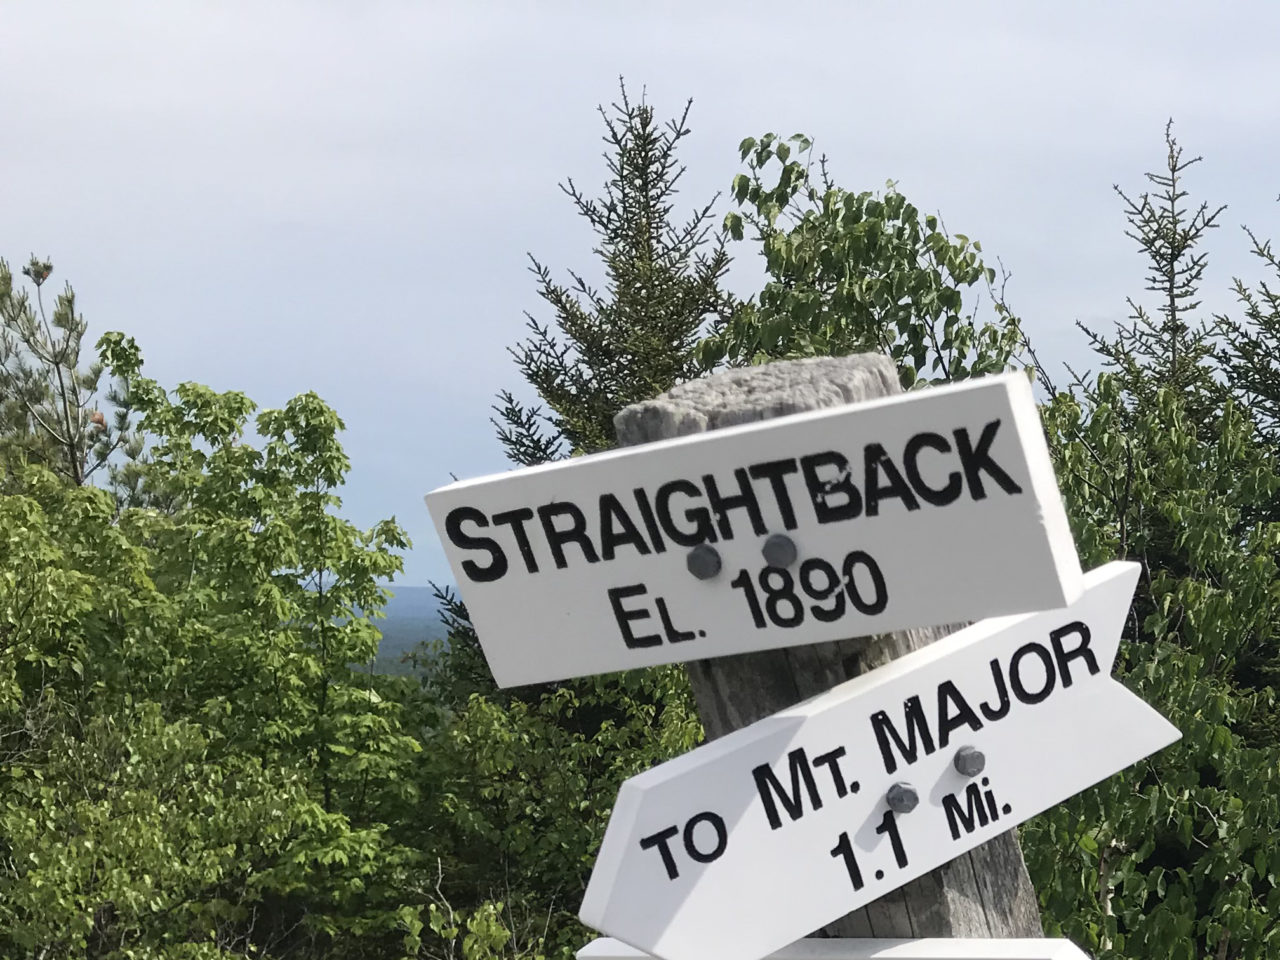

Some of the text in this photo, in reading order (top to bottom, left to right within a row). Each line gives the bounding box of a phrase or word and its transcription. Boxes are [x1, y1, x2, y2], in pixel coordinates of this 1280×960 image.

[445, 420, 1022, 582] STRAIGHTBACK
[607, 550, 888, 650] EL. 1890
[640, 621, 1100, 879] TO MT. MAJOR
[830, 777, 1012, 892] 1.1 Mi.
